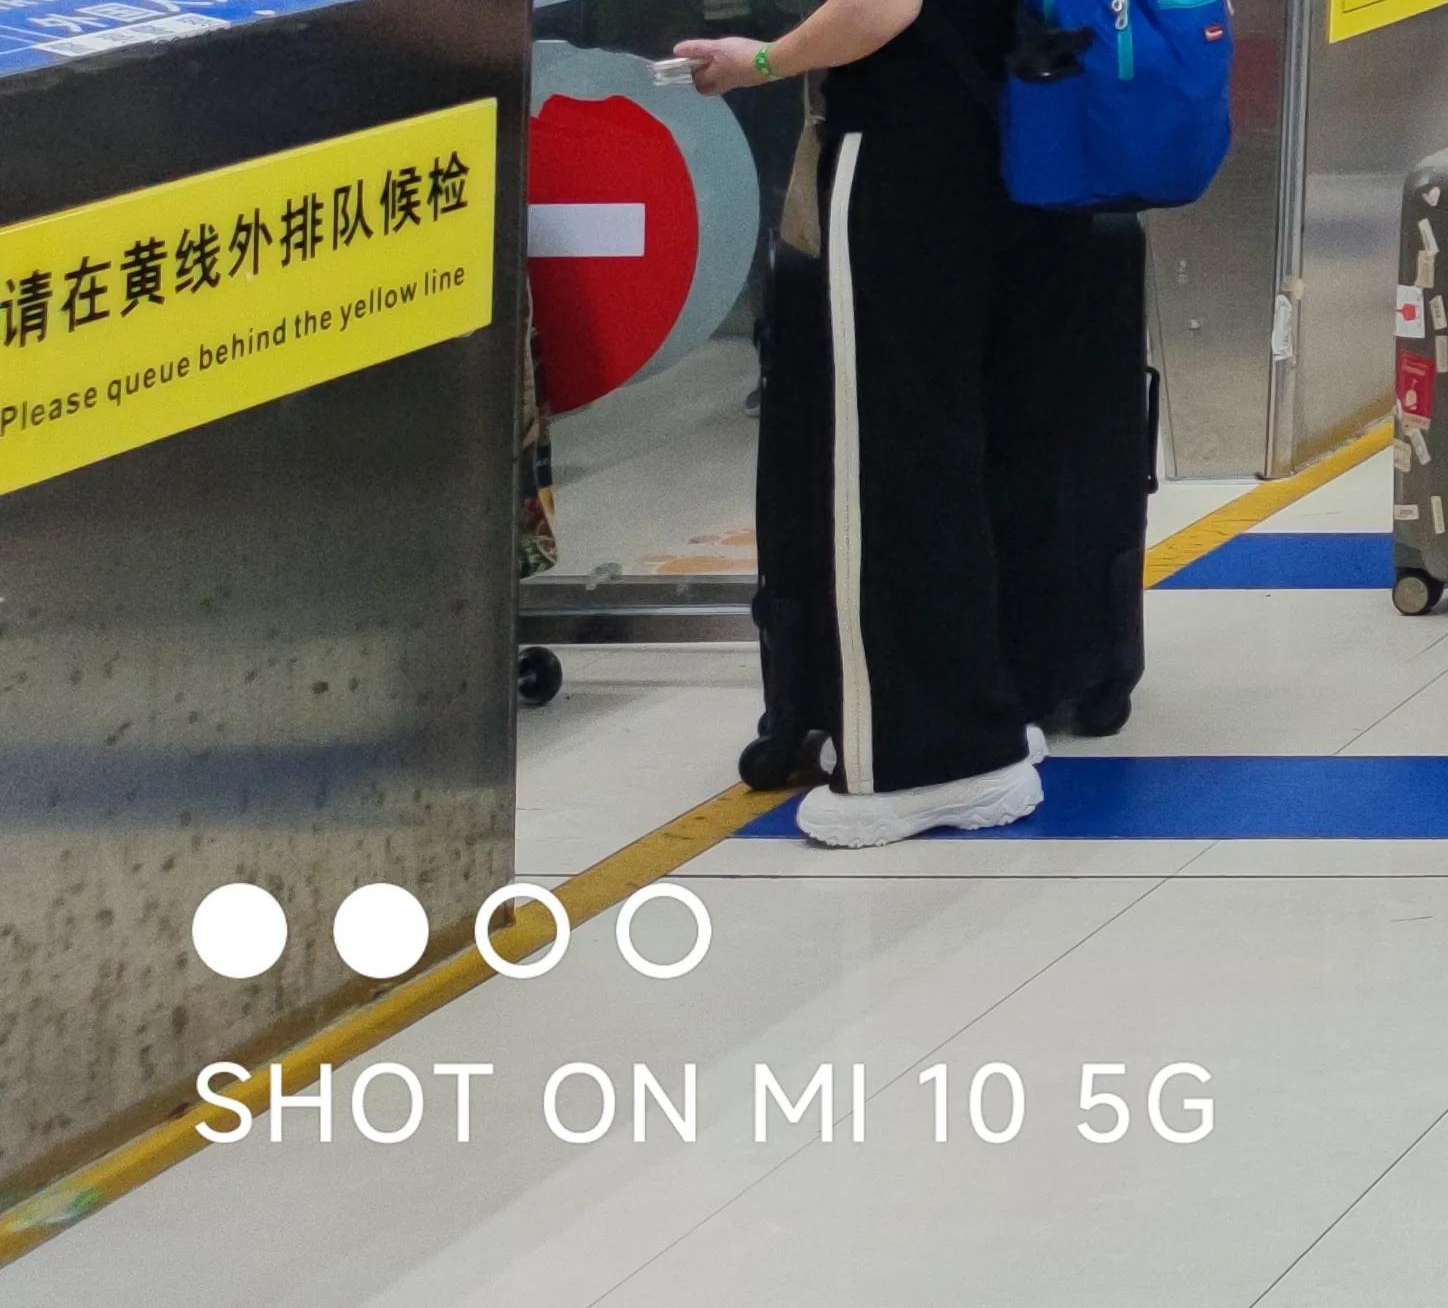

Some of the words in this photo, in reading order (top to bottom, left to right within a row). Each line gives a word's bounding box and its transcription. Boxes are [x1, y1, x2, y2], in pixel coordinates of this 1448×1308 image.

[0, 151, 471, 349] 请在黄线外排队候检
[0, 384, 99, 437] Please
[107, 356, 191, 407] queue
[200, 317, 288, 371] behind
[294, 311, 333, 340] the
[339, 282, 419, 332] yellow
[424, 264, 466, 298] line
